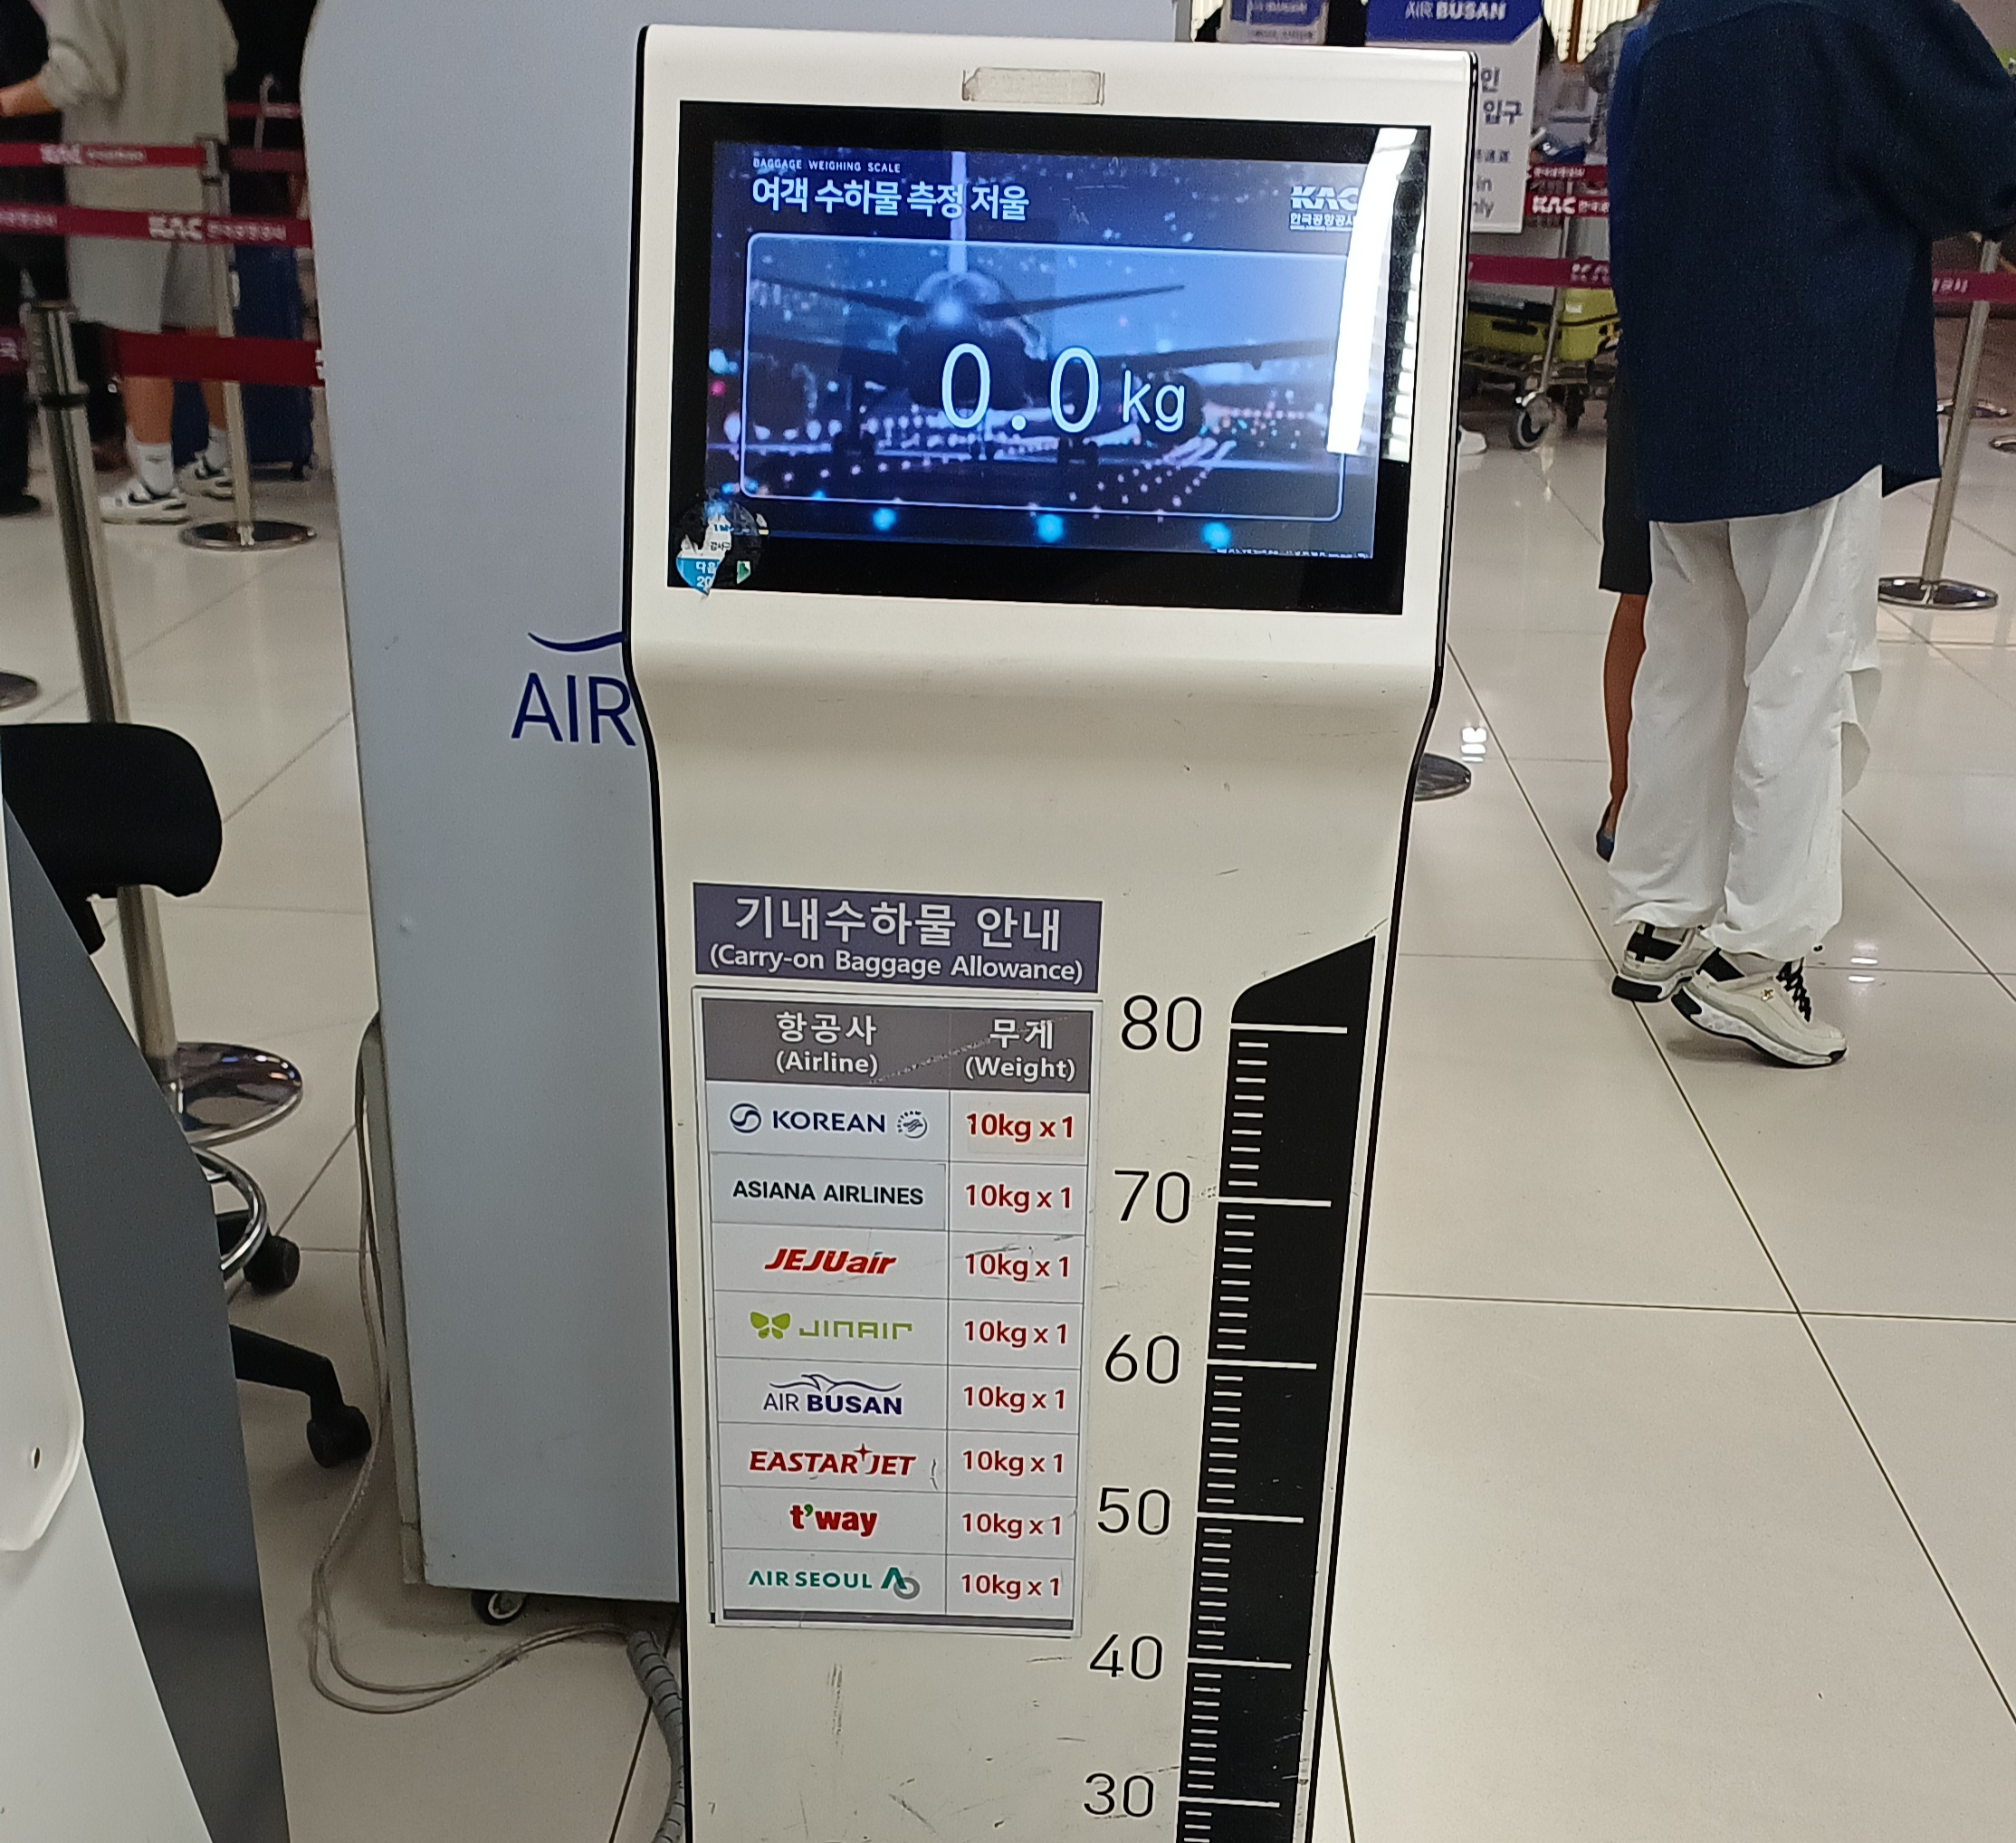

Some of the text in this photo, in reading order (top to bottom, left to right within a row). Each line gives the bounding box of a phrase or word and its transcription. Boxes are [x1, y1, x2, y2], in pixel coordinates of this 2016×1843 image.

[1436, 1, 1506, 20] BUSAN
[753, 158, 901, 173] BAGGAGE WEIGHING SCALE
[752, 177, 1029, 221] 여객 수하물 측정 저울
[941, 342, 1185, 433] 0.0 kg
[511, 673, 635, 746] AIR
[736, 897, 1059, 950] 기내수하물 안내
[711, 944, 1082, 984] (Carry-on Baggage Allowance)
[777, 1012, 1052, 1049] 항공사 무게
[1122, 995, 1201, 1051] 80
[777, 1051, 1075, 1082] (Airline) (Weight)
[773, 1111, 884, 1132] KOREAN
[967, 1113, 1030, 1142] 10kg
[733, 1180, 922, 1205] ASIANA AIRLINES
[967, 1184, 1069, 1212] 10kg x 1
[1115, 1170, 1190, 1223] 70
[765, 1249, 896, 1274] JEJUair
[965, 1254, 1067, 1282] 10kg x 1
[965, 1321, 1065, 1348] 10kg x 1
[1105, 1334, 1179, 1383] 60
[764, 1393, 902, 1414] AIR BUSAN
[964, 1387, 1064, 1412] 10kg x 1
[749, 1450, 858, 1475] EASTAR
[963, 1450, 1062, 1476] 10kg x 1
[1098, 1487, 1170, 1535] 50
[963, 1514, 1061, 1538] 10kg x 1
[749, 1571, 872, 1588] AIR SEOUL
[962, 1574, 1060, 1599] 10kg x 1
[1090, 1635, 1161, 1679] 40
[1084, 1772, 1153, 1818] 30
